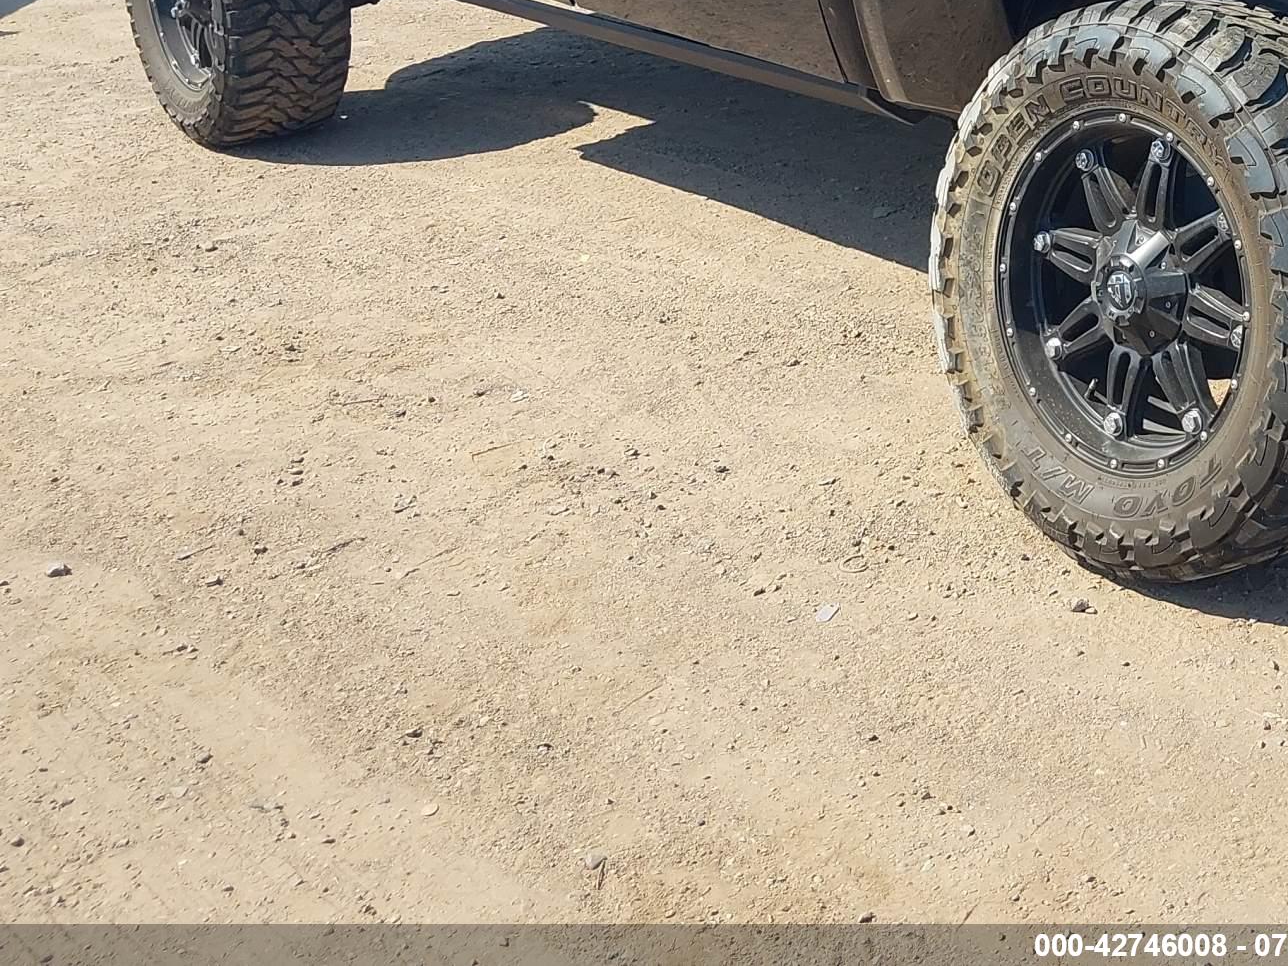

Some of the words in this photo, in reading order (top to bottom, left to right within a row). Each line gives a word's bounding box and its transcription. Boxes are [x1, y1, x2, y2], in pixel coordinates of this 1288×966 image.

[976, 93, 1051, 195] OPEN
[1059, 75, 1230, 174] COUNTRY
[1018, 444, 1095, 504] M/T
[1112, 457, 1223, 519] TOYO
